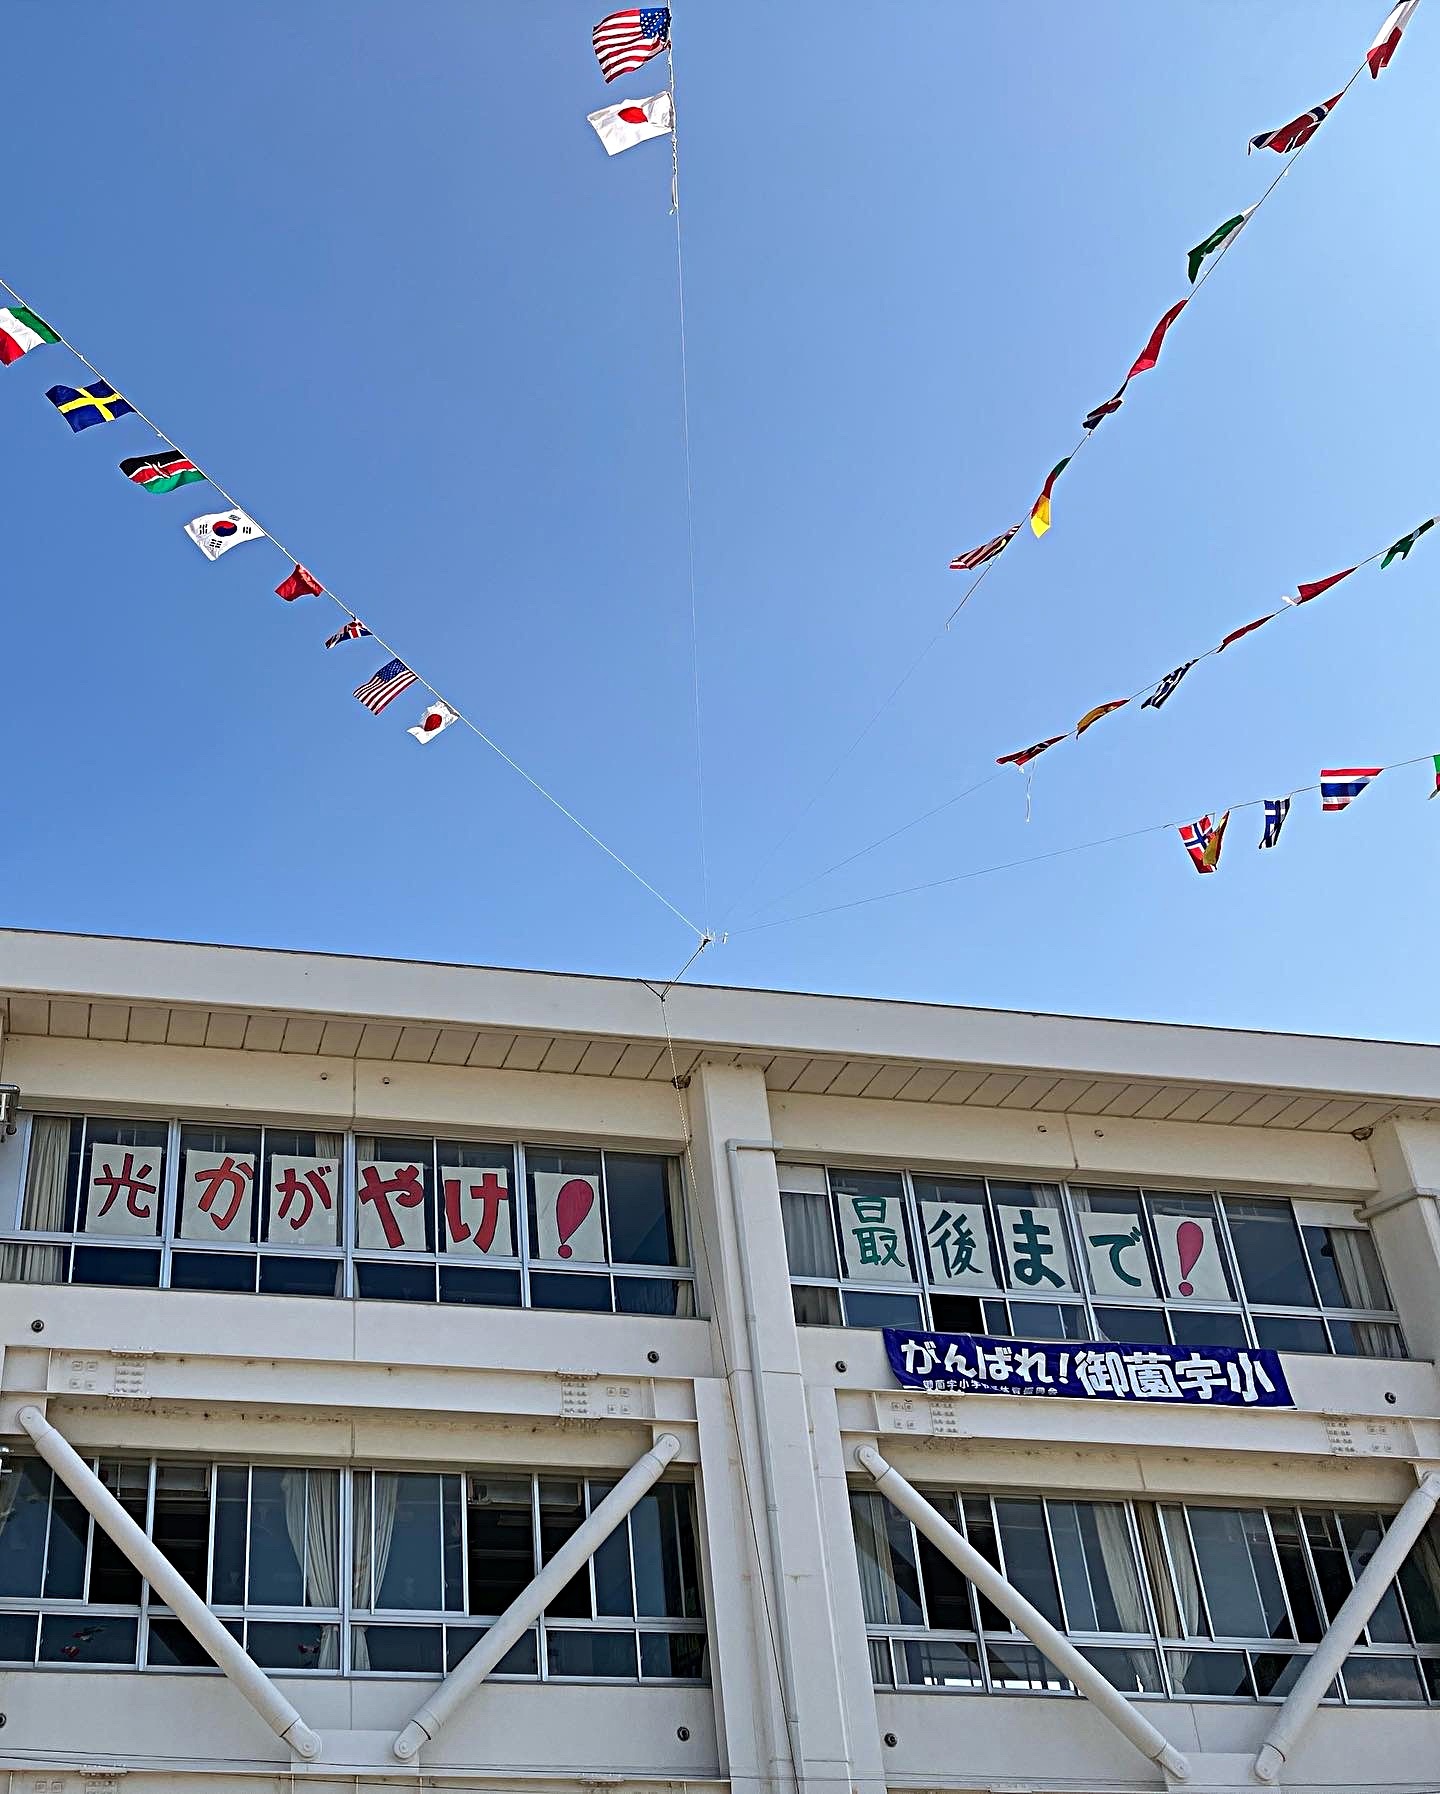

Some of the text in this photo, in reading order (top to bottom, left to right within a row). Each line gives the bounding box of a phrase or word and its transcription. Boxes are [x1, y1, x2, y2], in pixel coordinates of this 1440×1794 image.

[93, 1152, 595, 1259] 光かがやけ！
[848, 1195, 1205, 1298] 最後まで！
